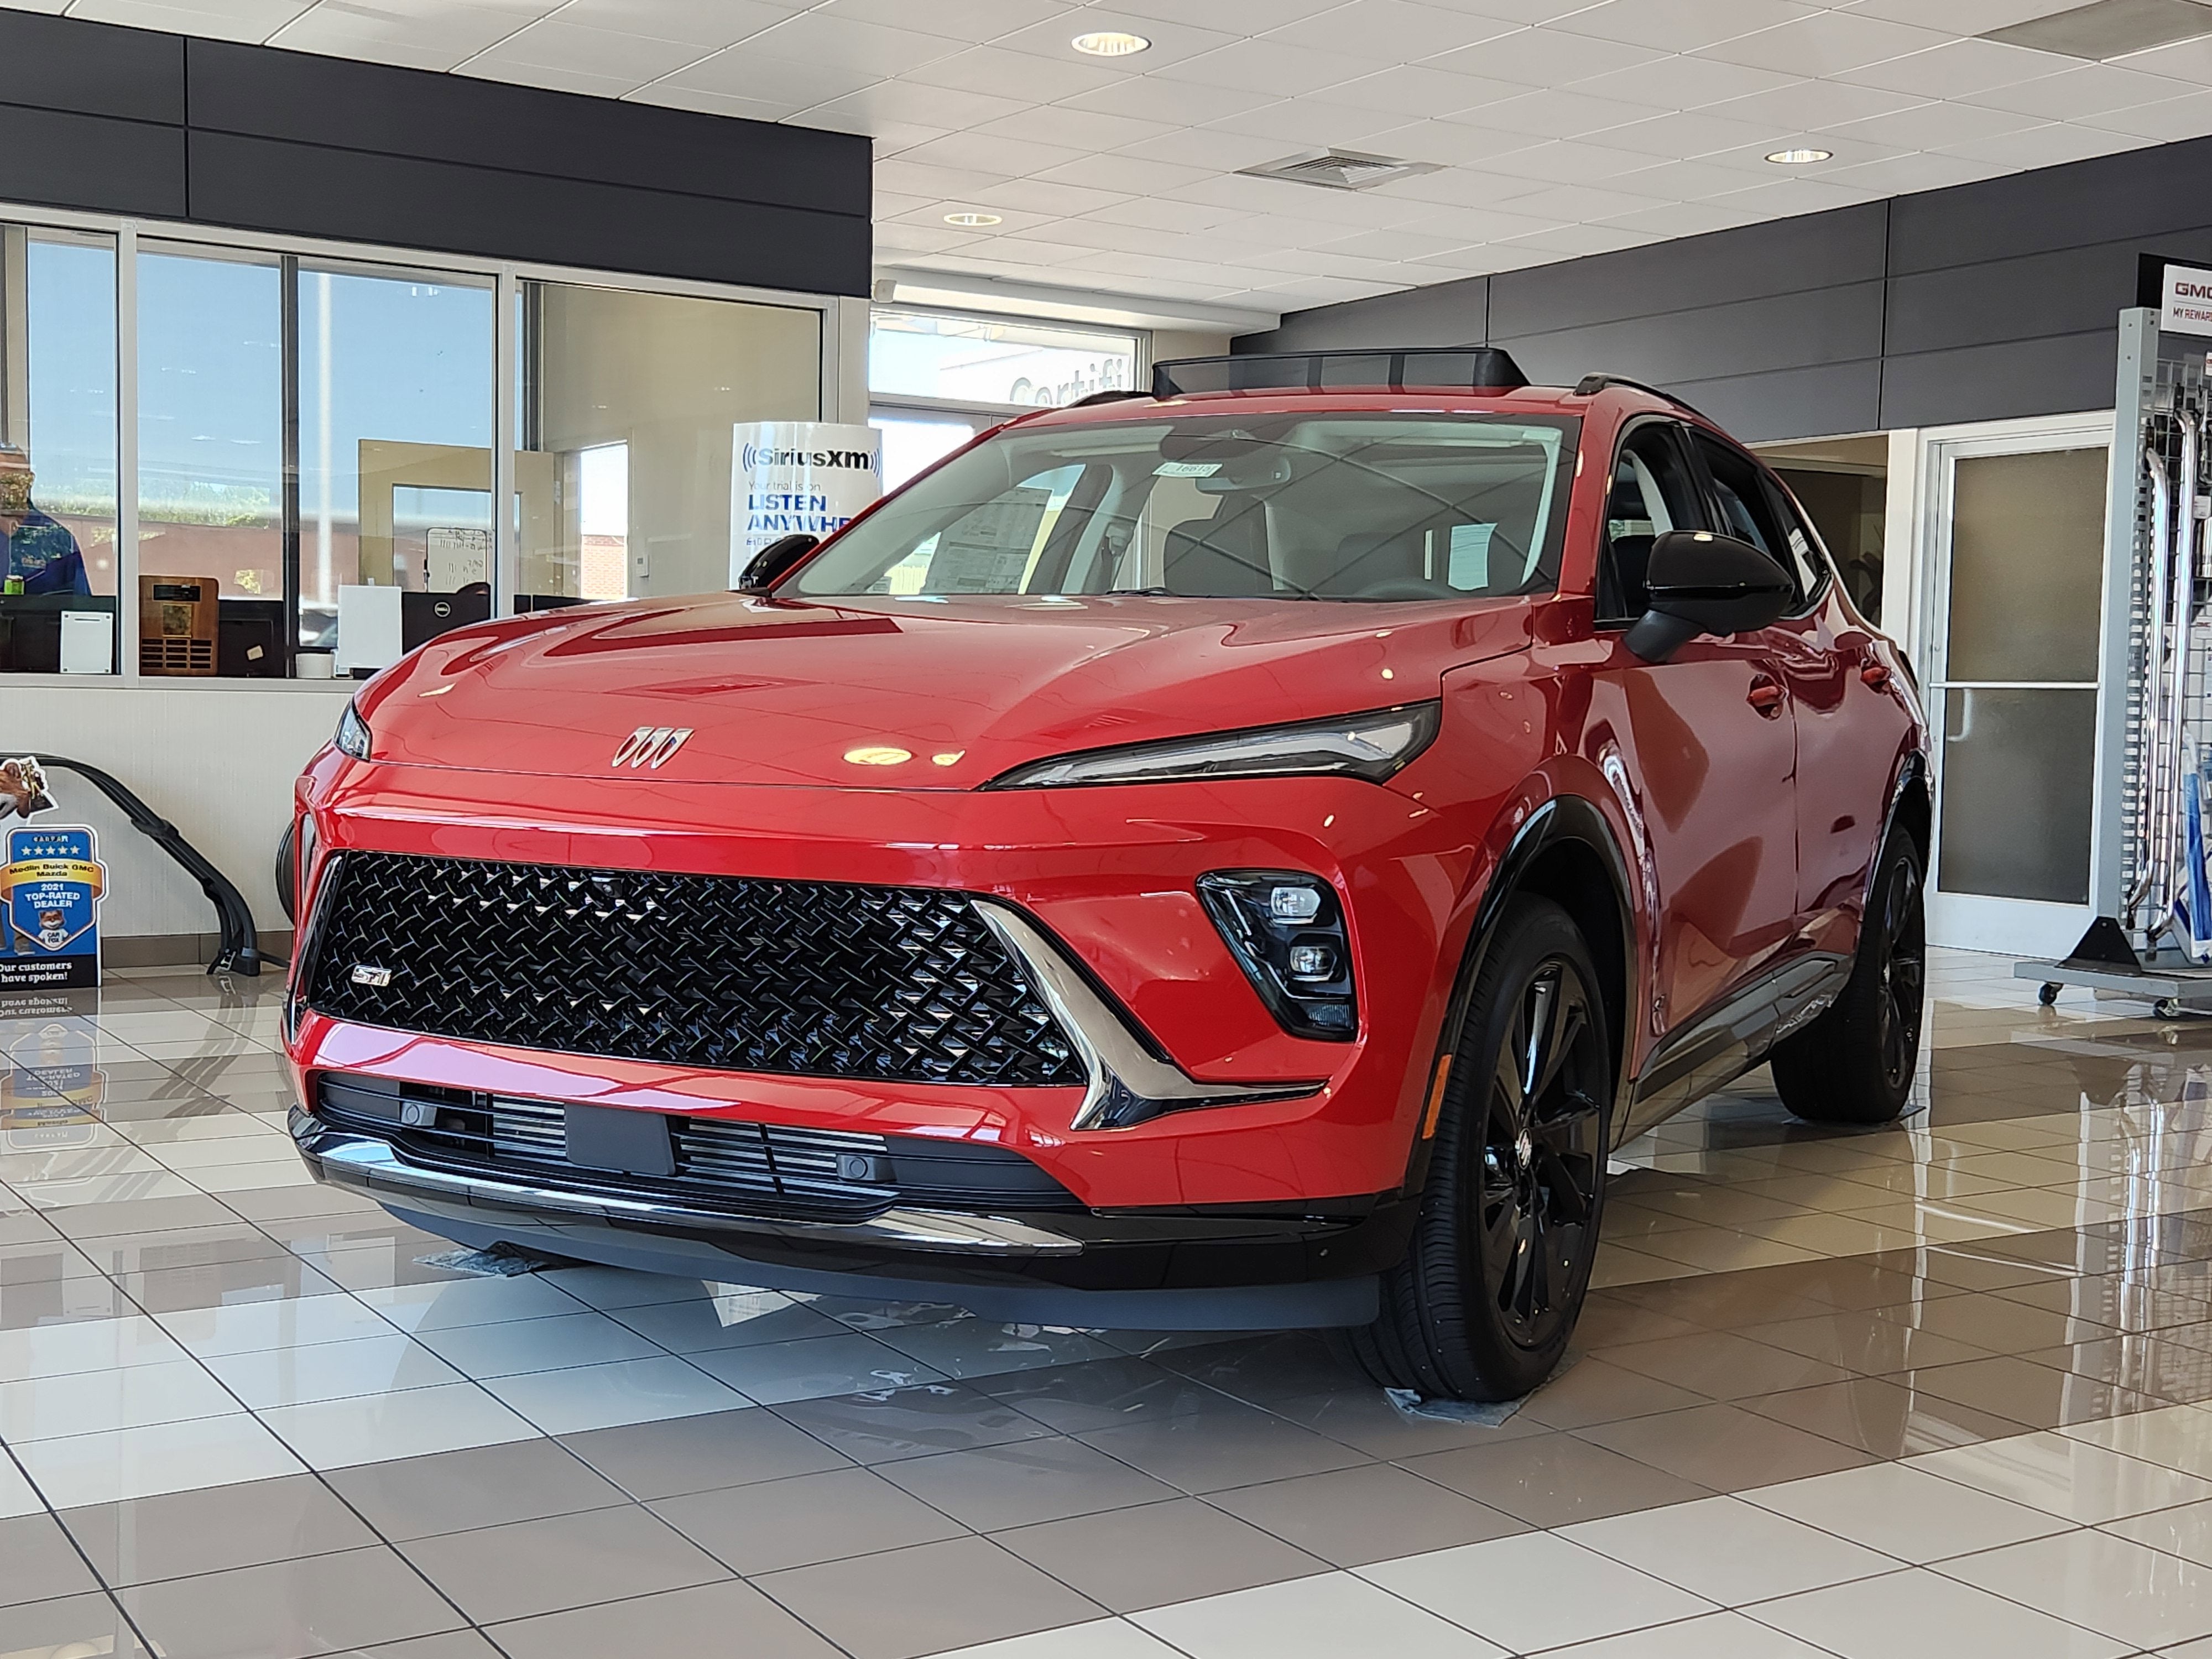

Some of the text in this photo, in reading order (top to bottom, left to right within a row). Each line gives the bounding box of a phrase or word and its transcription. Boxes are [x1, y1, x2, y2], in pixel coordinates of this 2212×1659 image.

[2173, 307, 2184, 319] MY
[748, 481, 821, 492] Your trial is on
[748, 494, 827, 512] LISTEN
[71, 864, 95, 873] GMC
[40, 883, 64, 891] 2021
[24, 892, 81, 901] TOP-RATED
[34, 900, 73, 909] DEALER
[18, 962, 72, 972] customers
[1, 972, 68, 984] have spoken!
